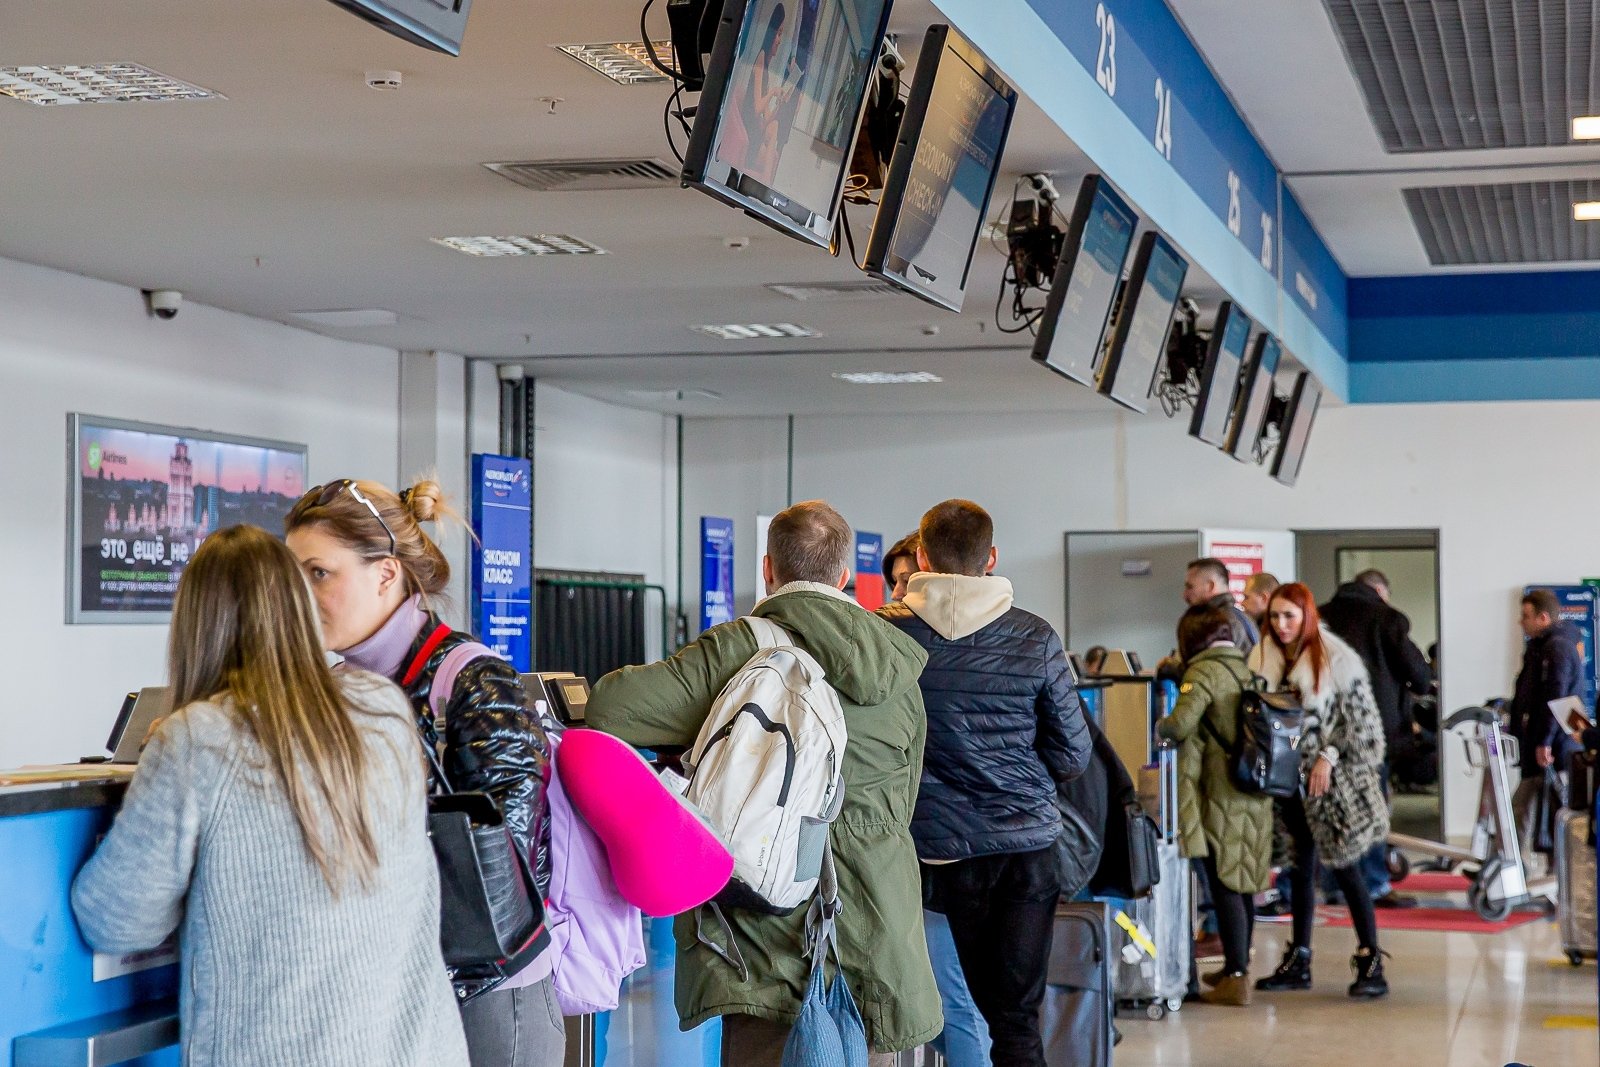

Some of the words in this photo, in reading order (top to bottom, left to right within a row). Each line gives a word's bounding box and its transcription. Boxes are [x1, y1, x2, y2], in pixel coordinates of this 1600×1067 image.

[1096, 2, 1117, 97] 23
[1154, 77, 1172, 161] 24
[917, 139, 956, 183] ECONOMY
[907, 177, 944, 218] CHECK-IN
[1227, 169, 1241, 237] 25
[483, 548, 521, 567] ЭКОНОМ
[483, 566, 514, 585] КЛАСС
[757, 846, 766, 867] Urban
